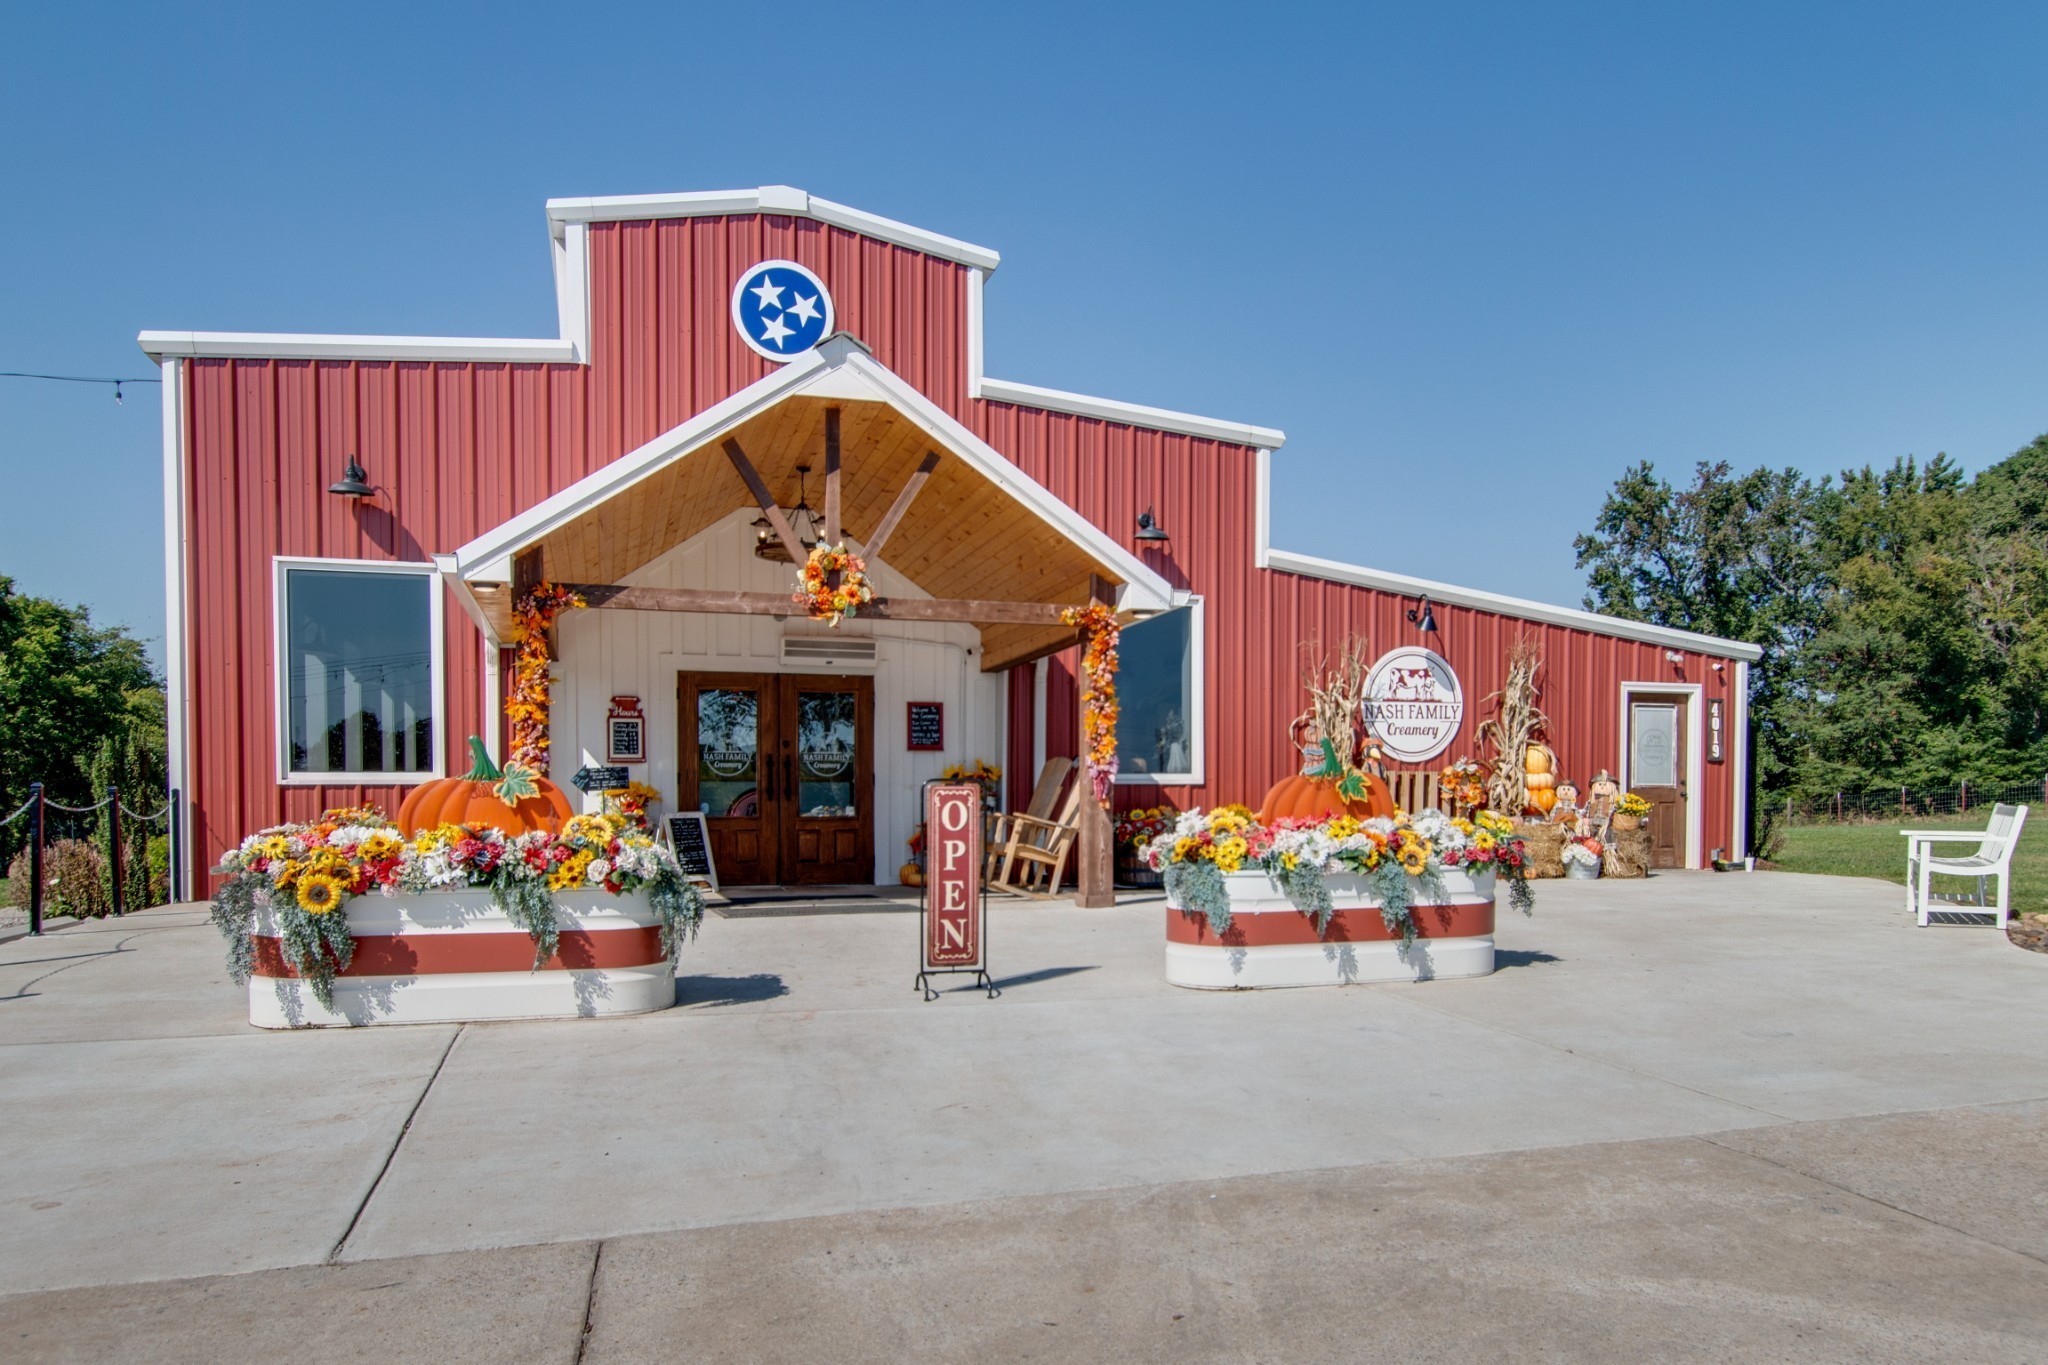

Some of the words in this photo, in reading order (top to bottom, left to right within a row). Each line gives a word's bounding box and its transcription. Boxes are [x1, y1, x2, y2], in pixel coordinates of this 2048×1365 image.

[613, 706, 639, 717] Hours
[1364, 704, 1404, 720] NASH
[1408, 704, 1460, 720] FAMILY
[1387, 722, 1439, 740] Creamery
[1711, 702, 1720, 758] 4019
[703, 752, 724, 761] NASH
[725, 752, 752, 761] FAMILY
[803, 752, 823, 762] NASH
[825, 752, 850, 762] FAMILY
[714, 760, 743, 770] Creamery
[813, 761, 842, 771] Creamery
[941, 800, 968, 950] OPEN
